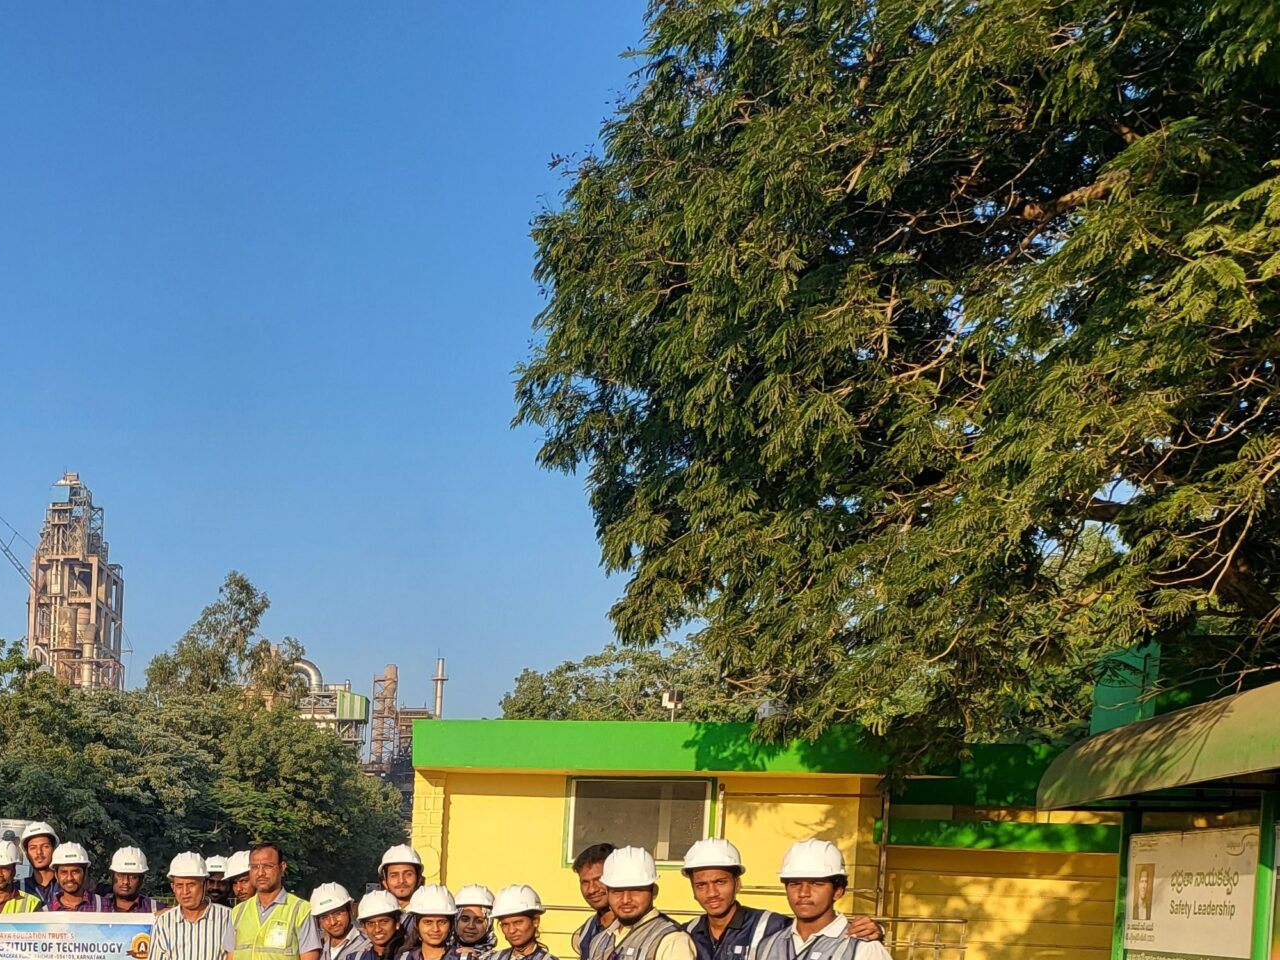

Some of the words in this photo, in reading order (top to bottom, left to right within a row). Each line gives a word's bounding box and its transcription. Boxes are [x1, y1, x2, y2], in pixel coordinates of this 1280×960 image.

[1169, 900, 1192, 919] Safety
[1193, 900, 1236, 920] Leadership
[41, 942, 54, 953] OF
[56, 942, 123, 953] TECHNOLOGY
